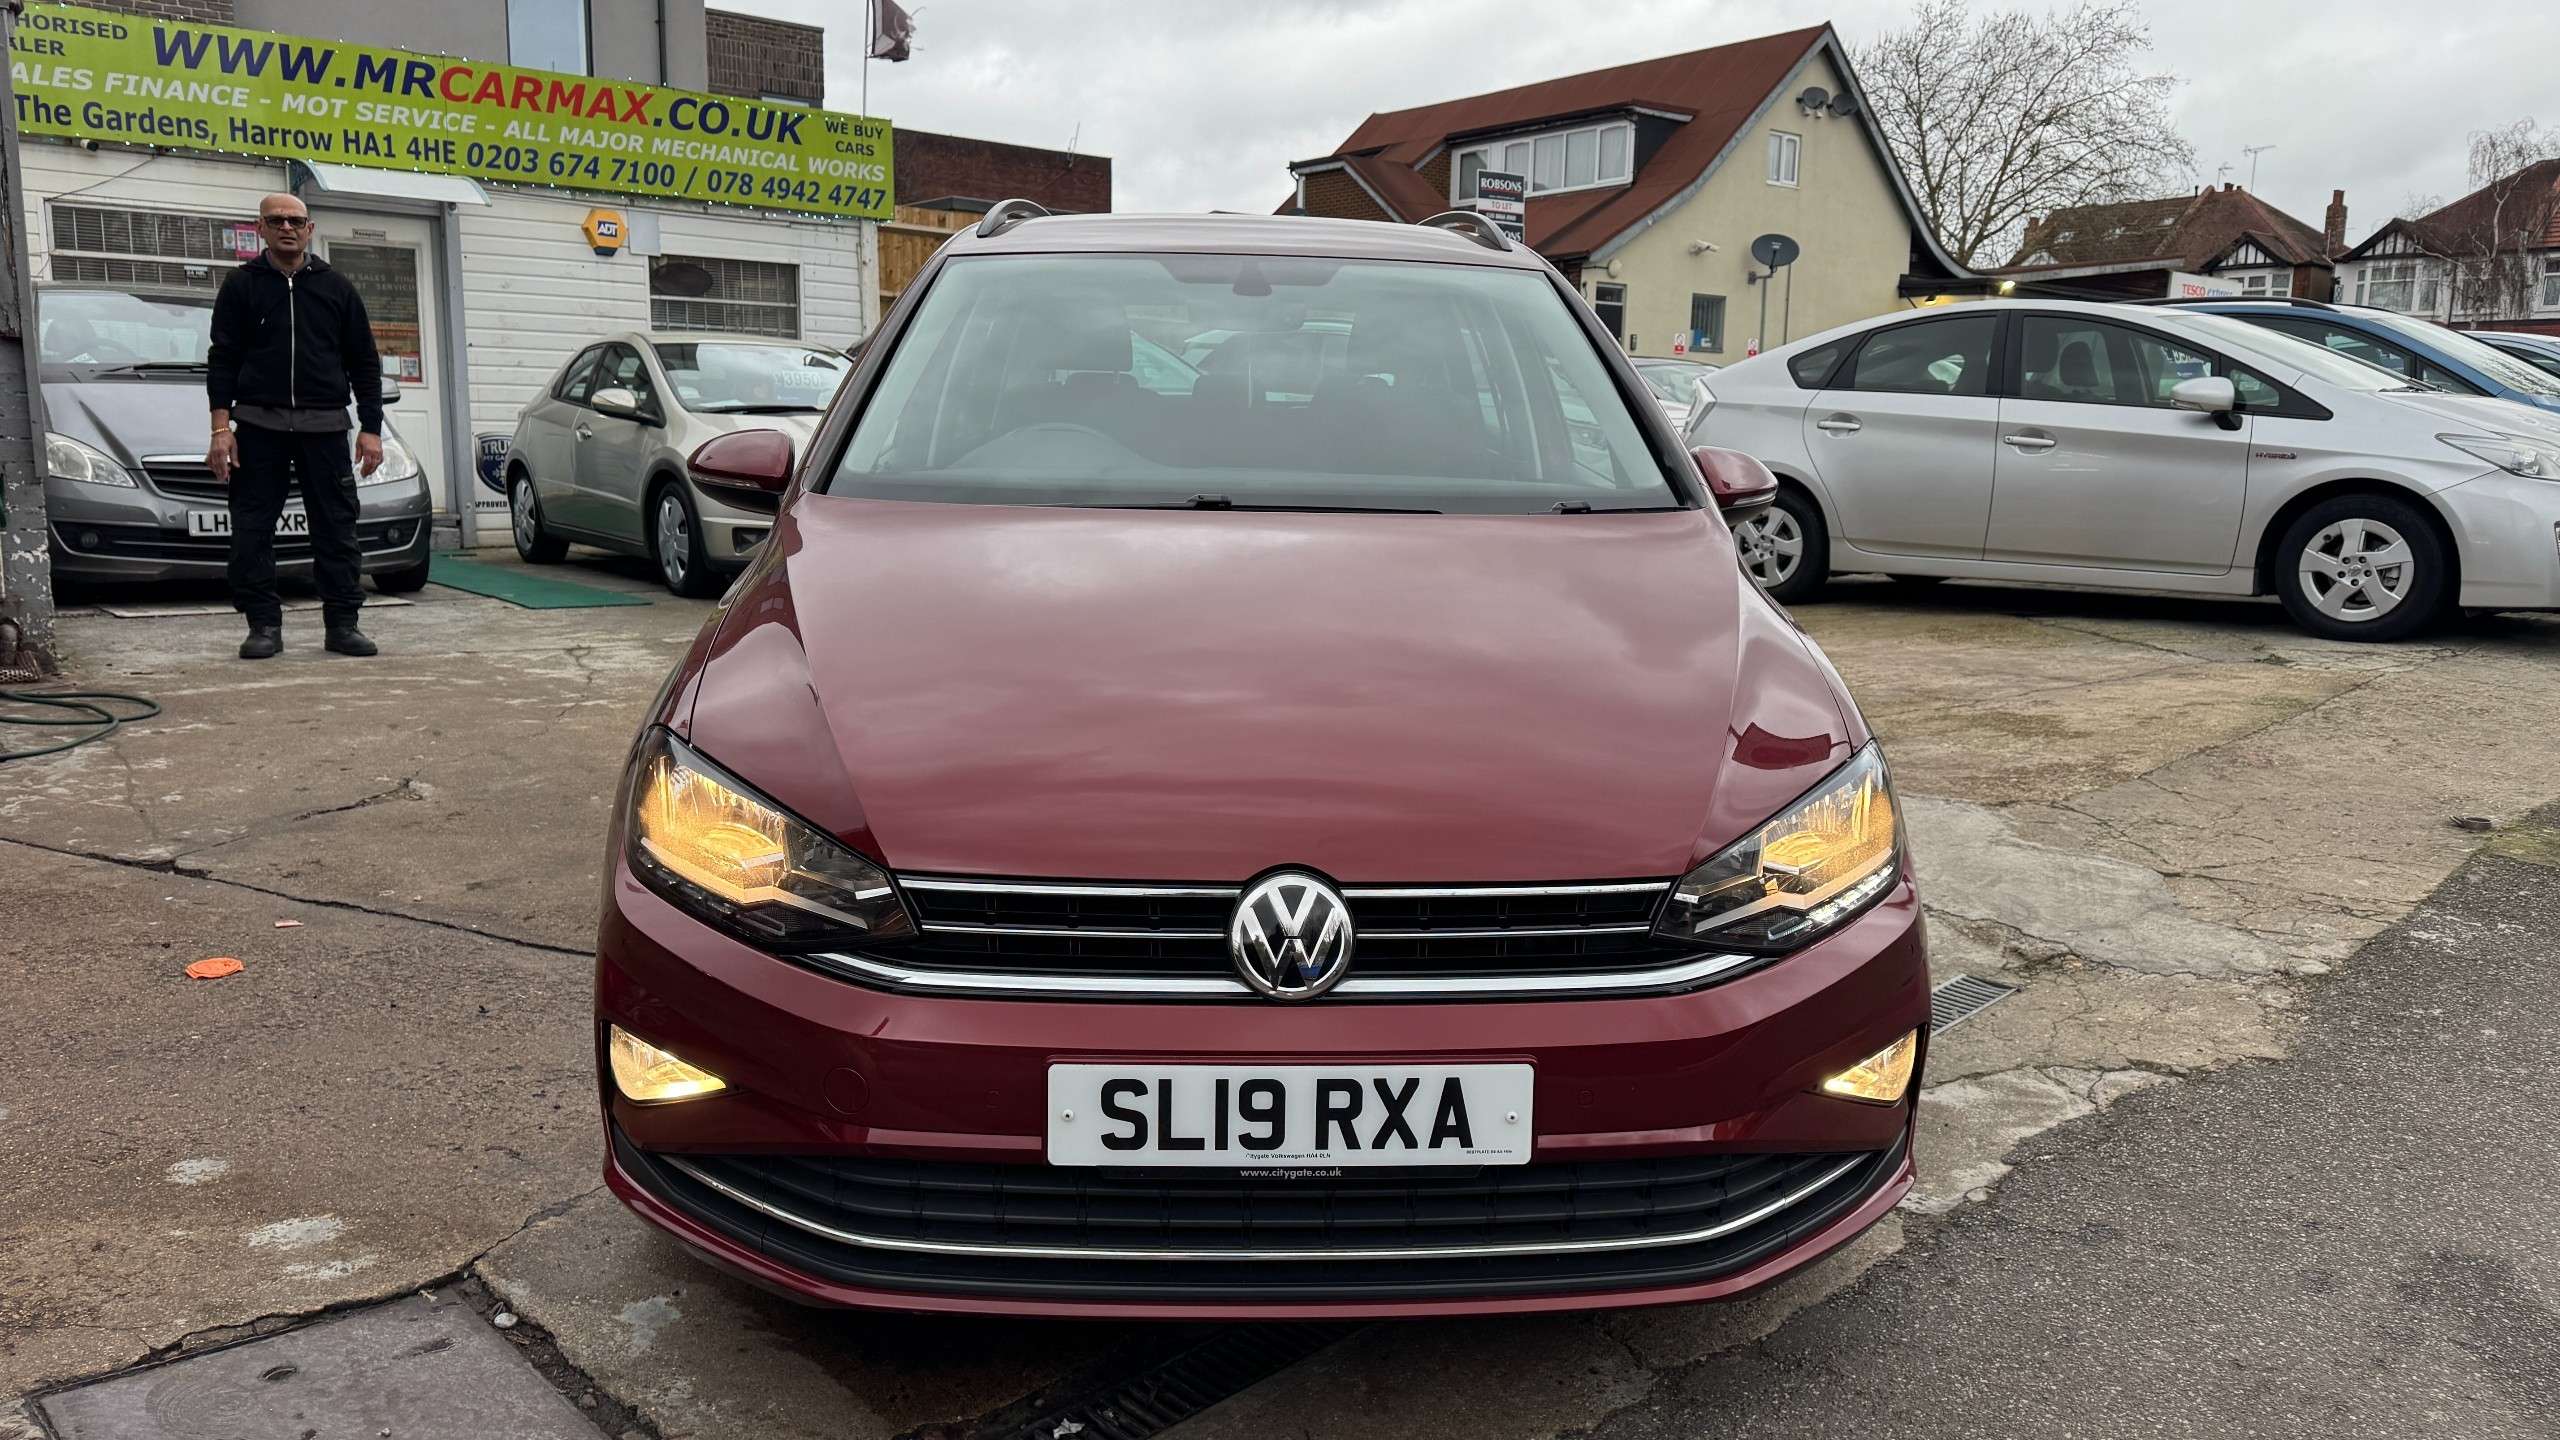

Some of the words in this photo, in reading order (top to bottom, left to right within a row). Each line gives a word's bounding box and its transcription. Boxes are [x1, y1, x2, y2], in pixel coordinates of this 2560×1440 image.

[104, 71, 250, 108] FINANCE
[281, 92, 349, 119] MOT
[355, 101, 478, 134] SERVICE
[503, 119, 551, 143] ALL
[559, 126, 645, 153] MAJOR
[651, 137, 800, 172] MECHANICAL
[808, 156, 886, 183] WORKS
[825, 120, 849, 135] WE
[854, 124, 884, 140] BUY
[14, 93, 72, 126] The
[82, 101, 218, 146] Gardens,
[229, 116, 333, 152] Harrow
[343, 128, 396, 159] HA1
[406, 136, 457, 166] 4HE
[466, 142, 539, 173] 0203
[549, 152, 600, 180] 674
[610, 158, 676, 188] 7100
[707, 169, 754, 195] 078
[761, 176, 821, 204] 4942
[828, 184, 887, 211] 4747
[835, 140, 875, 157] CARS
[1480, 177, 1523, 192] ROBSONS
[598, 223, 617, 236] ADT
[2182, 283, 2206, 297] TESCO
[1100, 1077, 1287, 1151] SL19
[1314, 1076, 1475, 1151] RXA
[1240, 1167, 1342, 1179] www.citygate.co.uk
